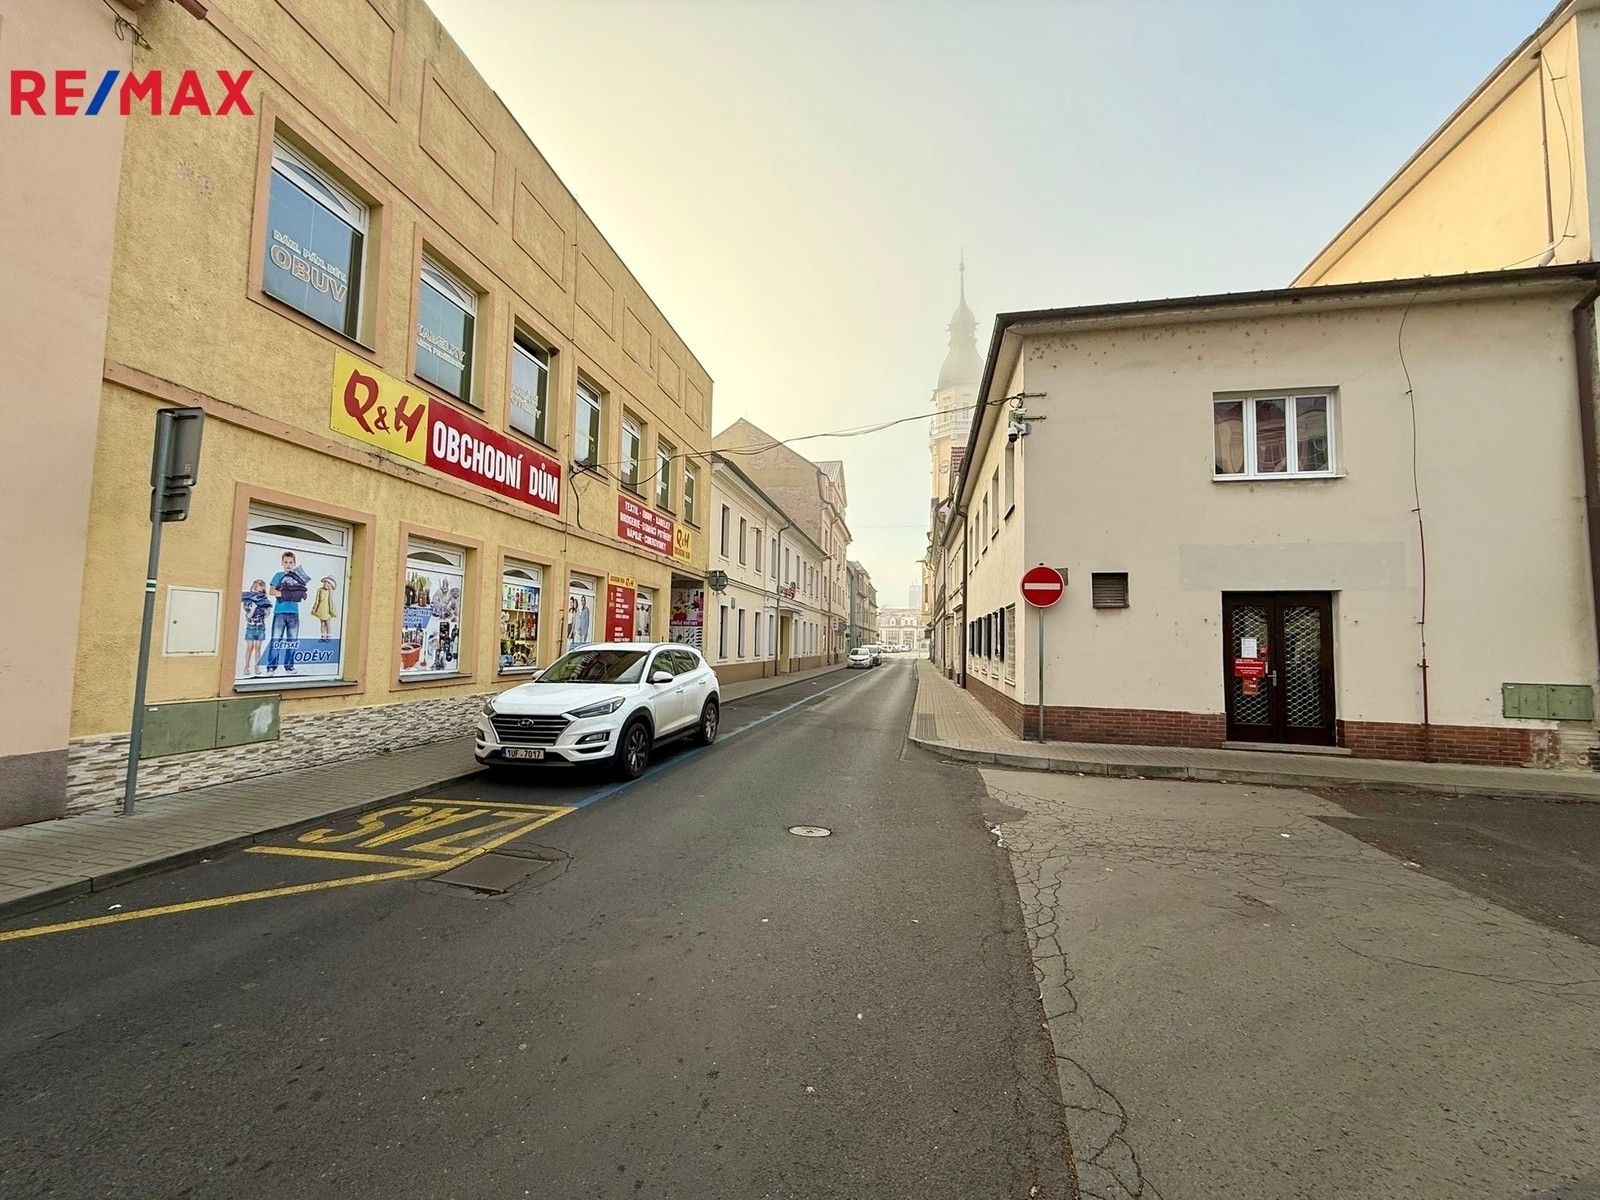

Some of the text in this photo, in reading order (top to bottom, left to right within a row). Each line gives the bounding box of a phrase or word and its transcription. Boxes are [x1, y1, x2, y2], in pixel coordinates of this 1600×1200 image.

[270, 244, 348, 303] OBUV
[432, 420, 559, 505] OBCHODNÍ DŮM
[294, 649, 333, 662] ODĚVY
